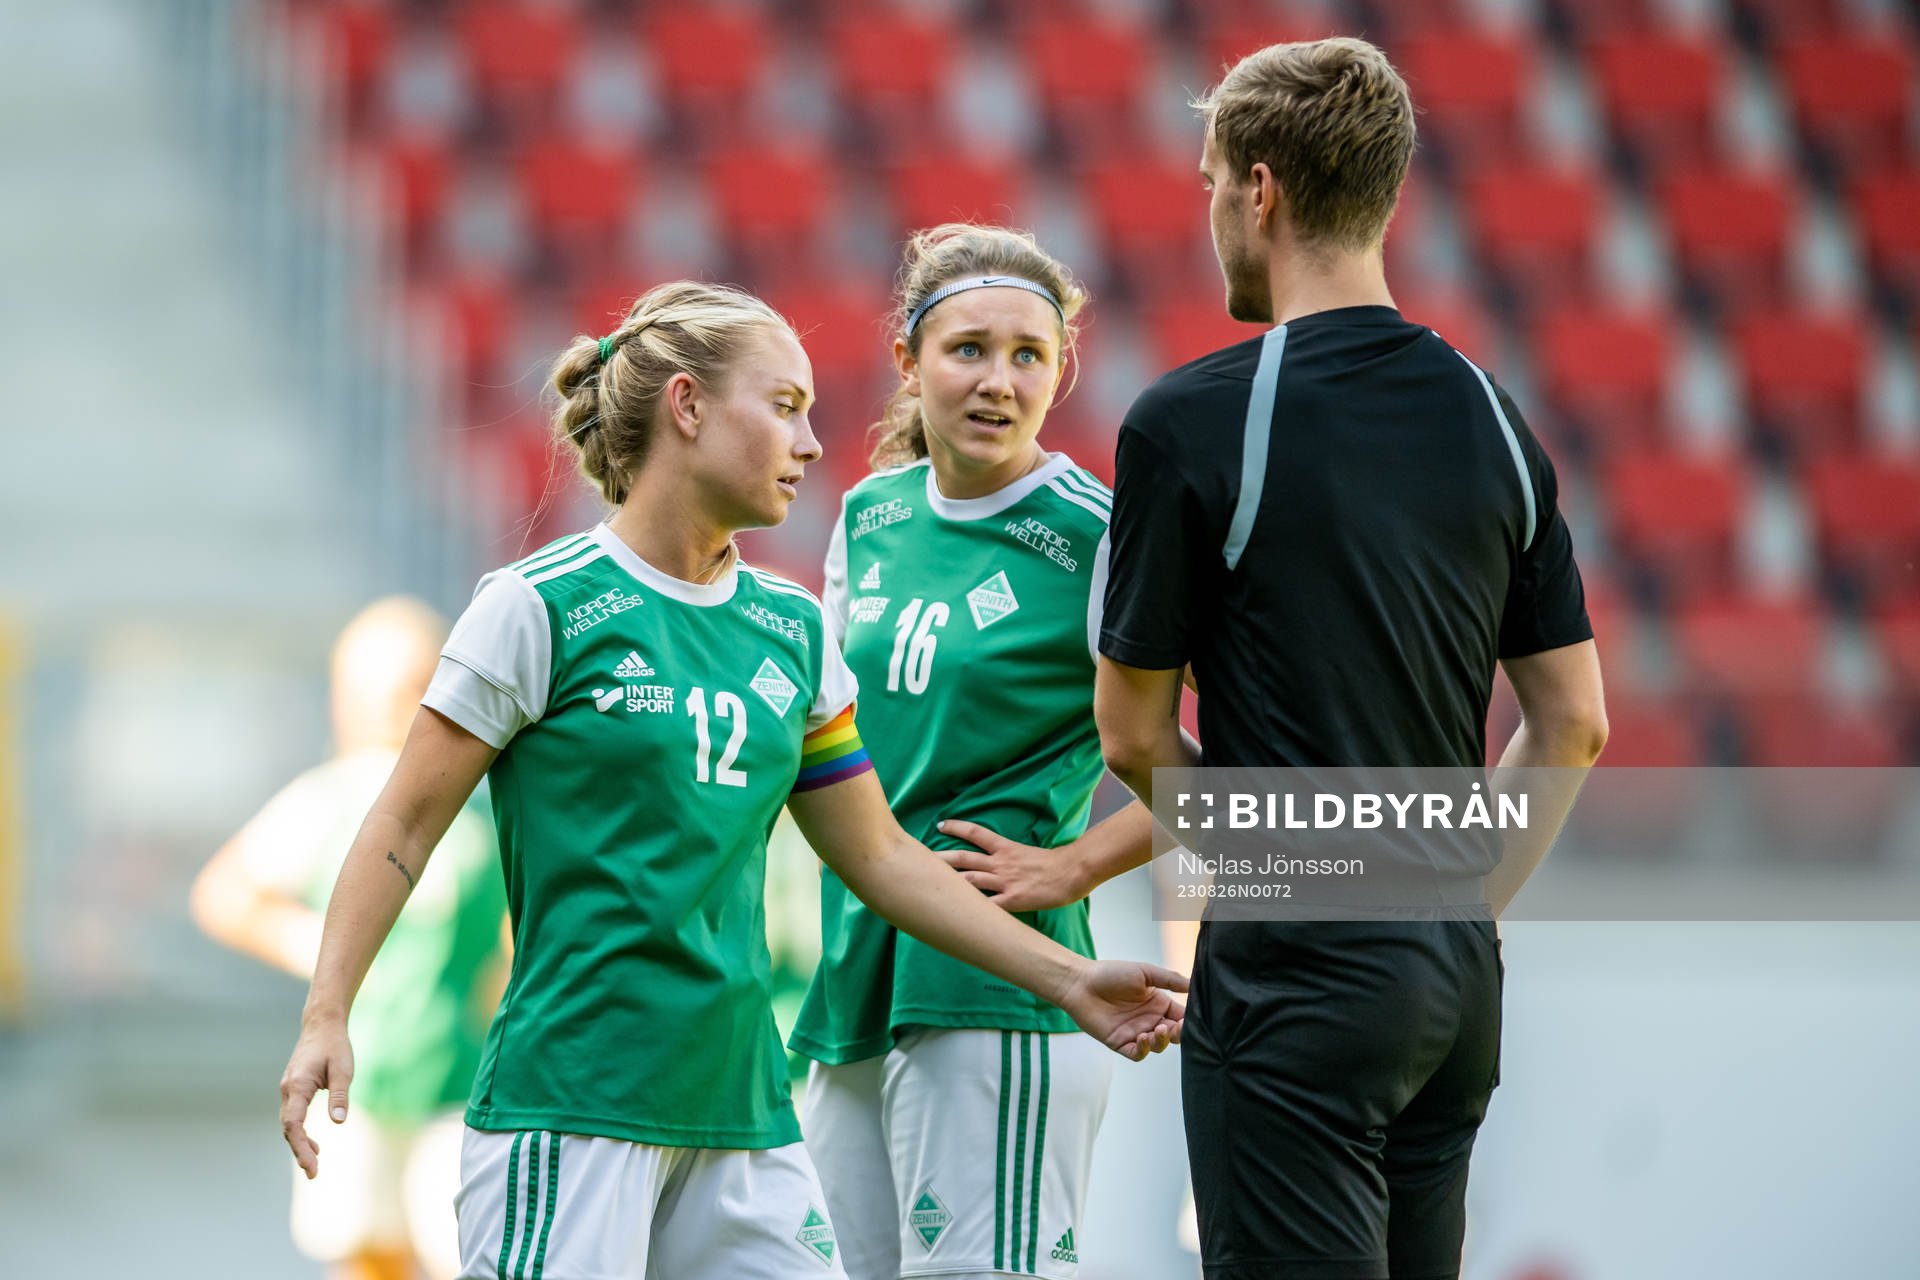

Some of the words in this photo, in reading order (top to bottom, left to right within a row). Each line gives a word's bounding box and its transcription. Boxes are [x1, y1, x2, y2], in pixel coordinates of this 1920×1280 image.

[856, 498, 903, 523] NORDIC
[851, 507, 913, 541] WELLNESS
[1021, 517, 1071, 552] NORDIC
[1004, 521, 1078, 573] WELLNESS
[566, 587, 624, 624] NORDIC
[972, 591, 1012, 611] ZENITH
[562, 594, 644, 640] WELLNESS
[751, 602, 805, 632] NORDIC
[854, 610, 884, 624] SPORT
[887, 598, 950, 695] 16
[613, 666, 656, 677] adidas
[626, 684, 674, 699] INTER
[755, 681, 792, 695] ZENITH
[626, 698, 675, 714] SPORT
[685, 686, 748, 788] 12
[912, 1212, 946, 1225] ZENITH
[1051, 1247, 1078, 1264] adidas
